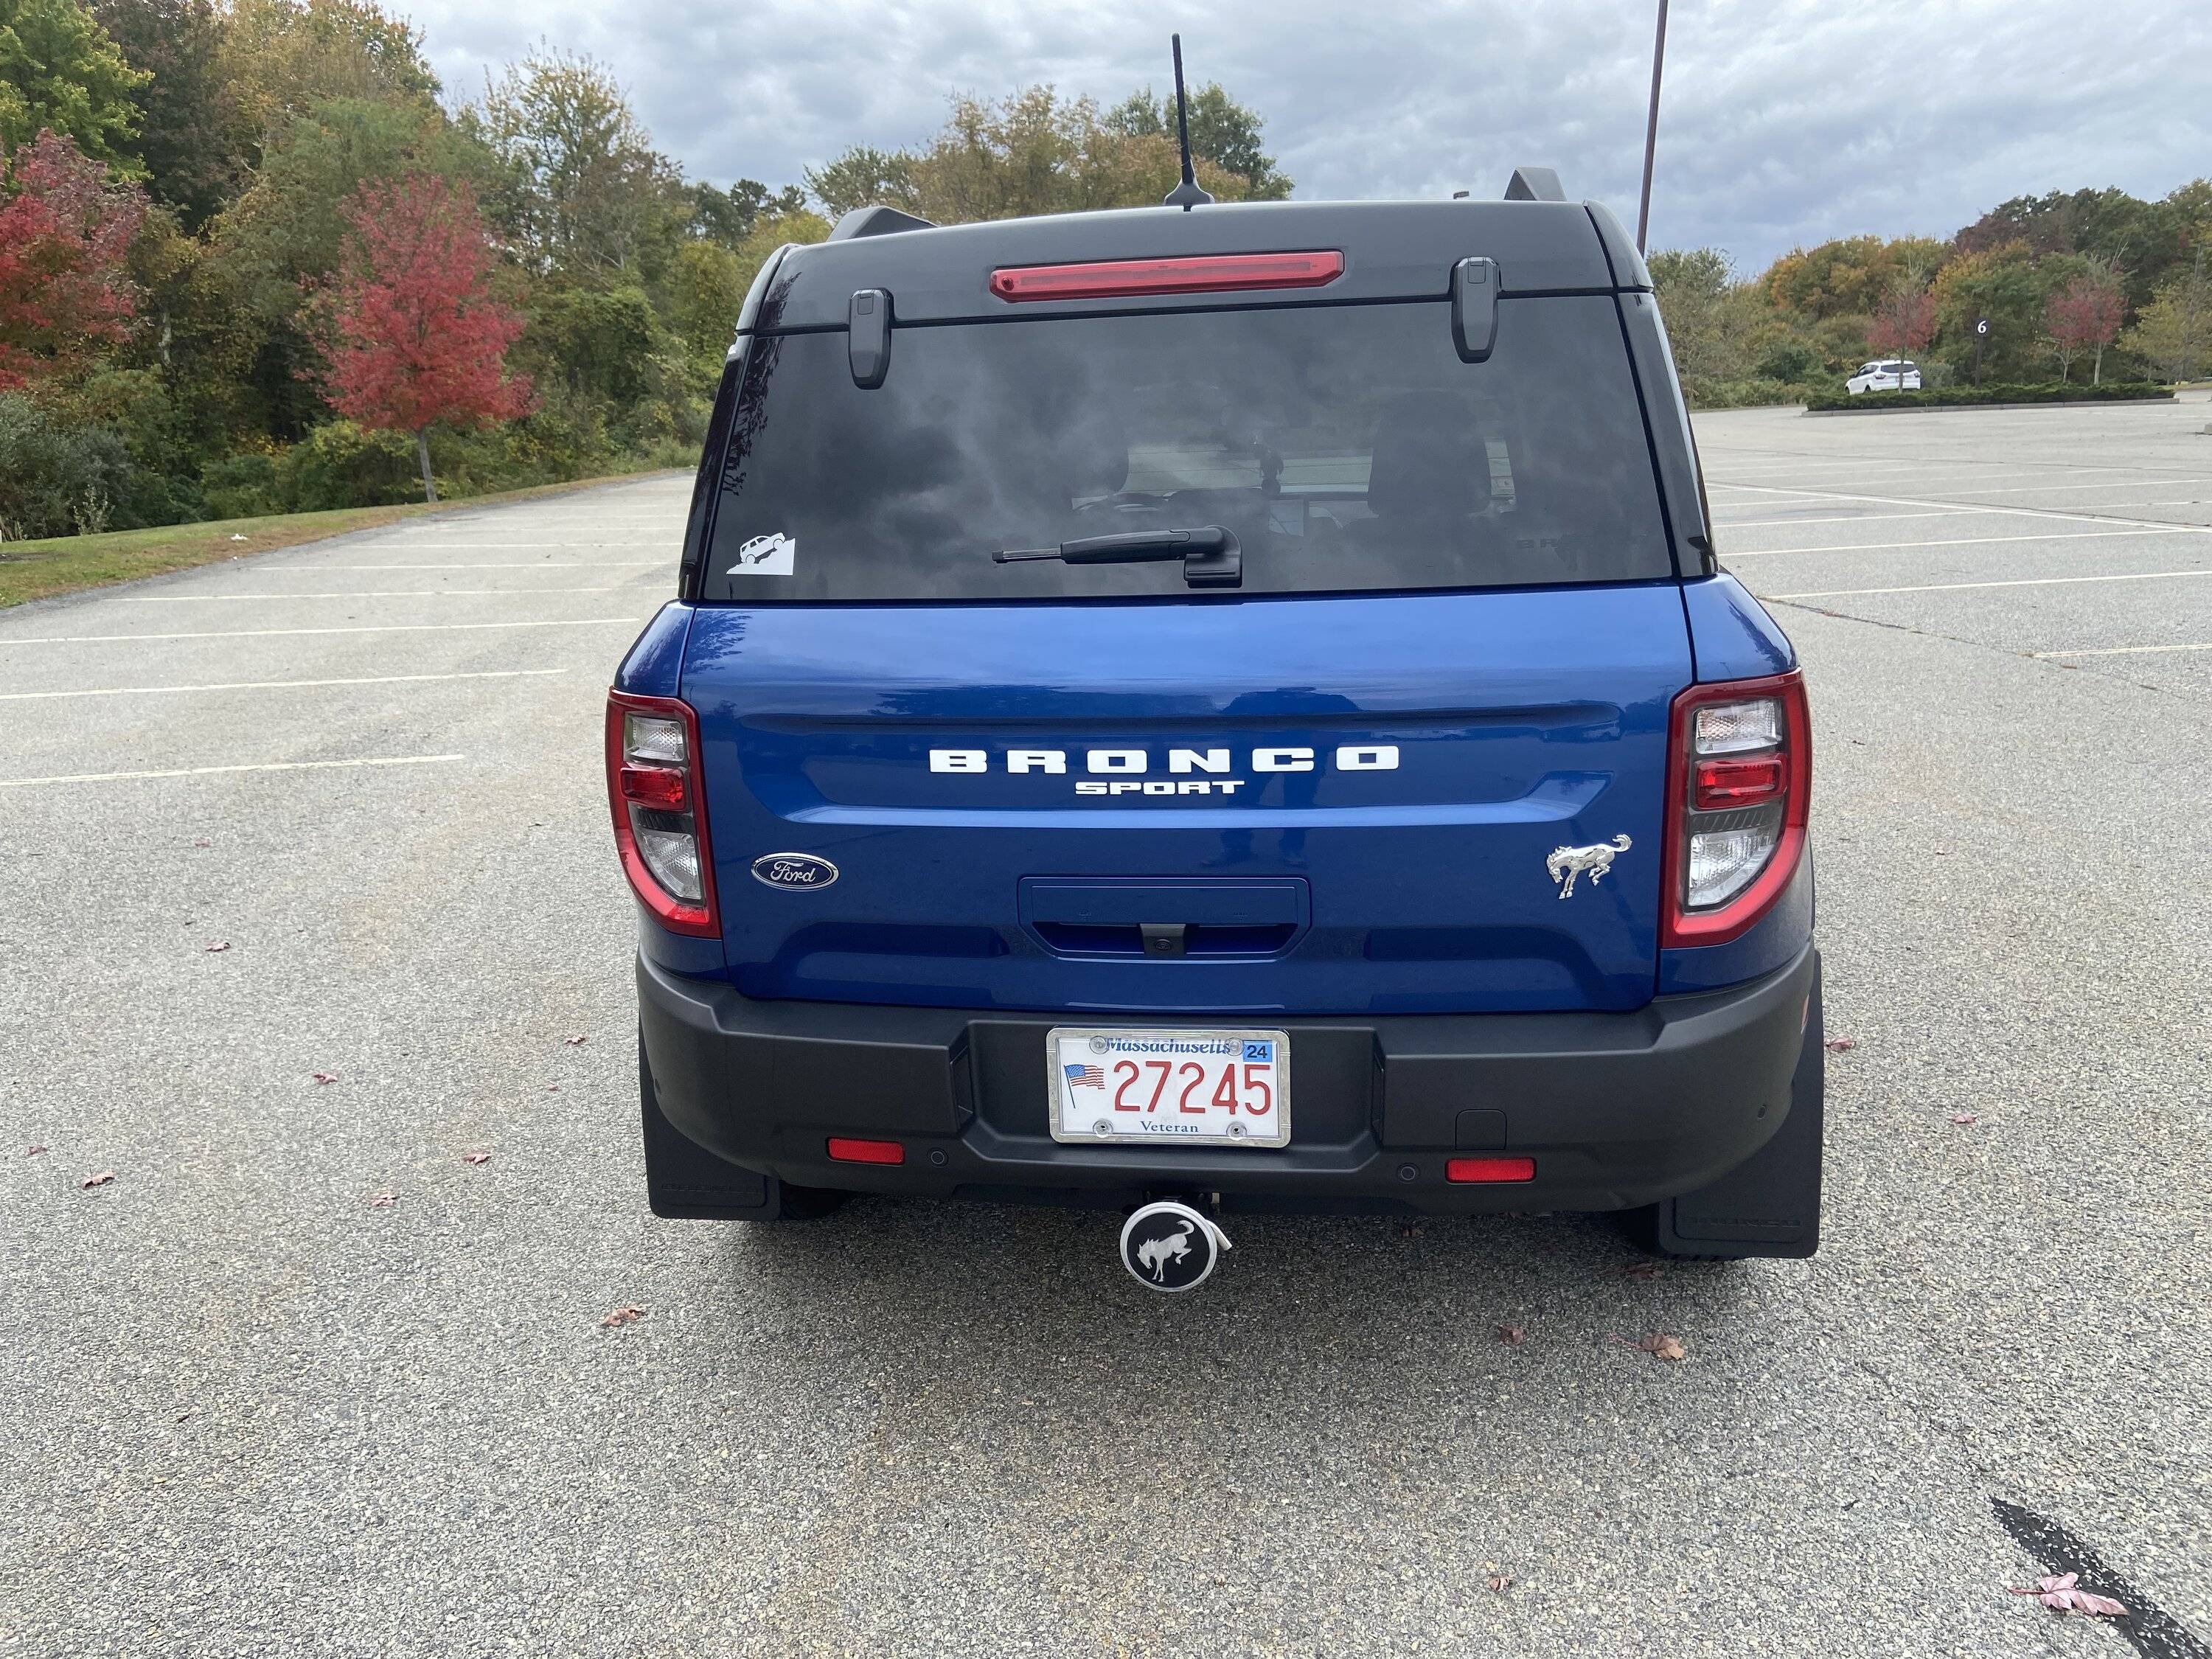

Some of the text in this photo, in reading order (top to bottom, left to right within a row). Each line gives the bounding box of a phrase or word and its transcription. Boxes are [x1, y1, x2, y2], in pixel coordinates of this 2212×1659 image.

[1977, 320, 1987, 334] 6
[929, 745, 1400, 774] BRONCO
[1075, 780, 1245, 796] SPORT
[770, 860, 816, 883] Ford
[1246, 1044, 1268, 1059] 24
[1113, 1060, 1271, 1116] 27245
[1141, 1121, 1199, 1133] Veteran
